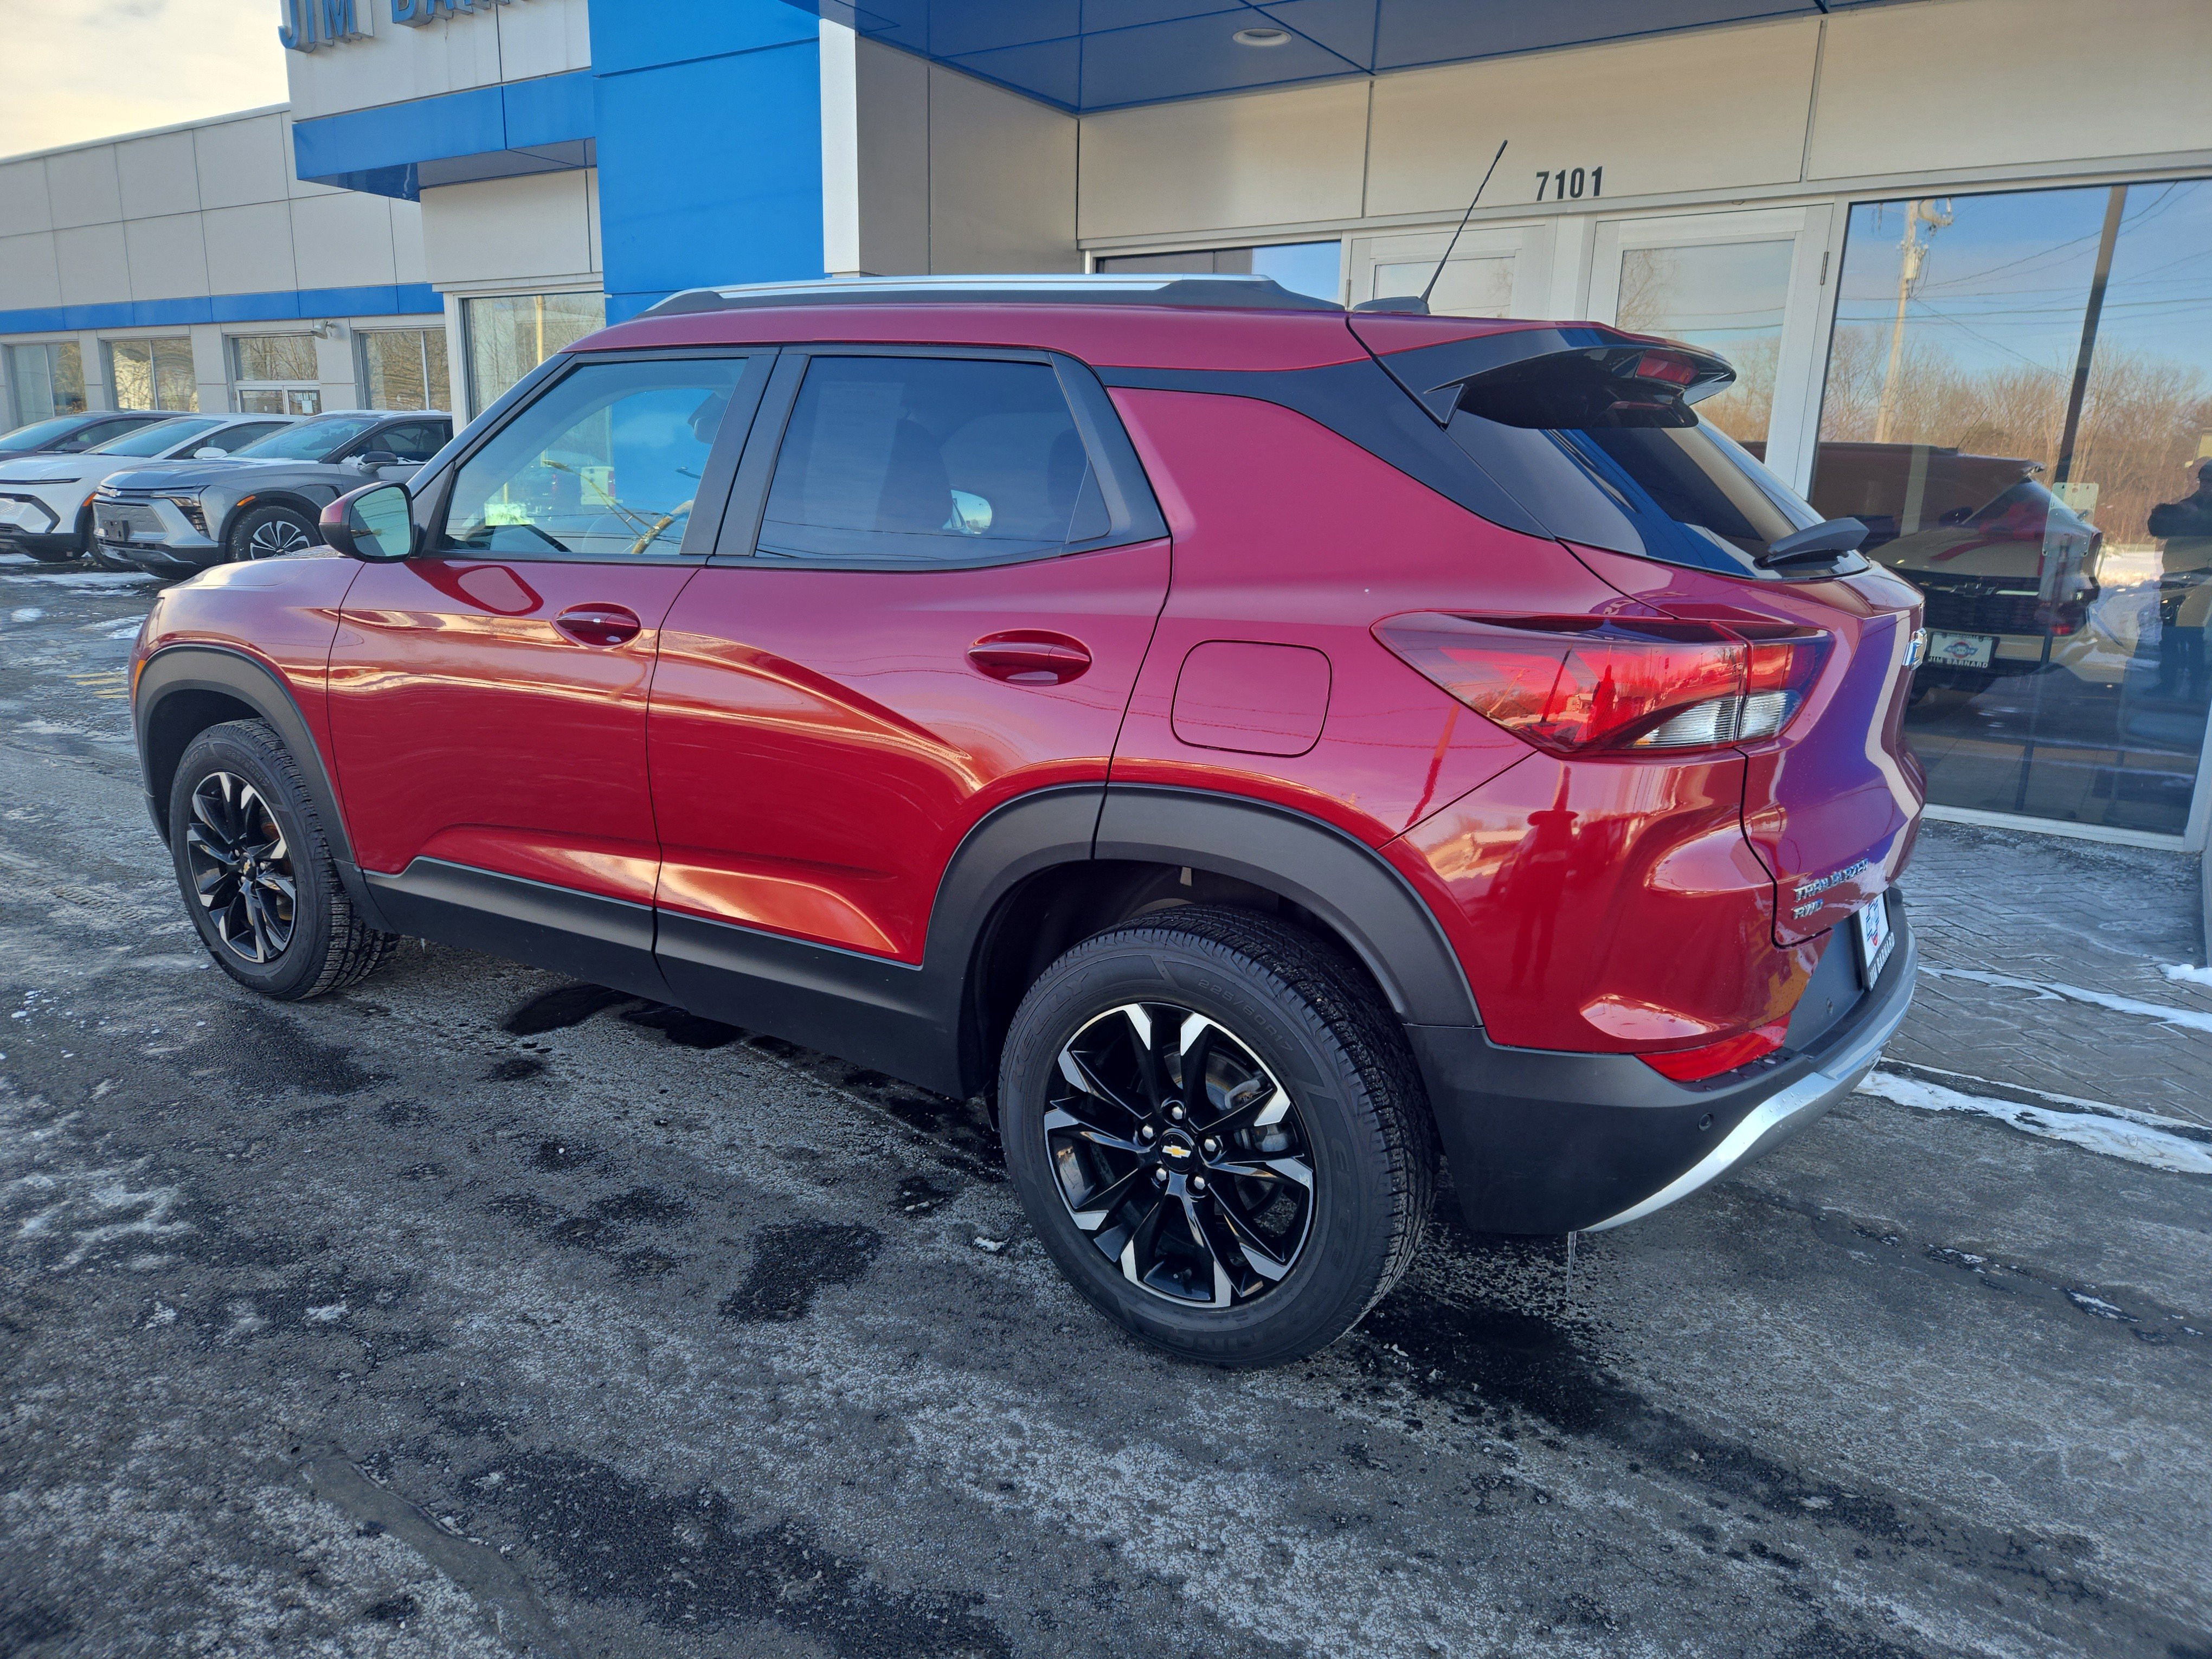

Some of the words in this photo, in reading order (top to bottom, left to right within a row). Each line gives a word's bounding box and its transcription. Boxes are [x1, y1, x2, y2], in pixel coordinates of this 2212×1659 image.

[278, 0, 358, 50] JIM
[1535, 165, 1603, 202] 7101
[1947, 659, 1989, 668] BARNARD
[1791, 858, 1869, 903] TRAILBLAZER
[1791, 898, 1824, 919] AWD
[1869, 963, 1877, 989] JIM
[1876, 931, 1895, 974] BARNARD
[1009, 971, 1095, 1090] KELLY
[1197, 977, 1296, 1057] 225/60R17
